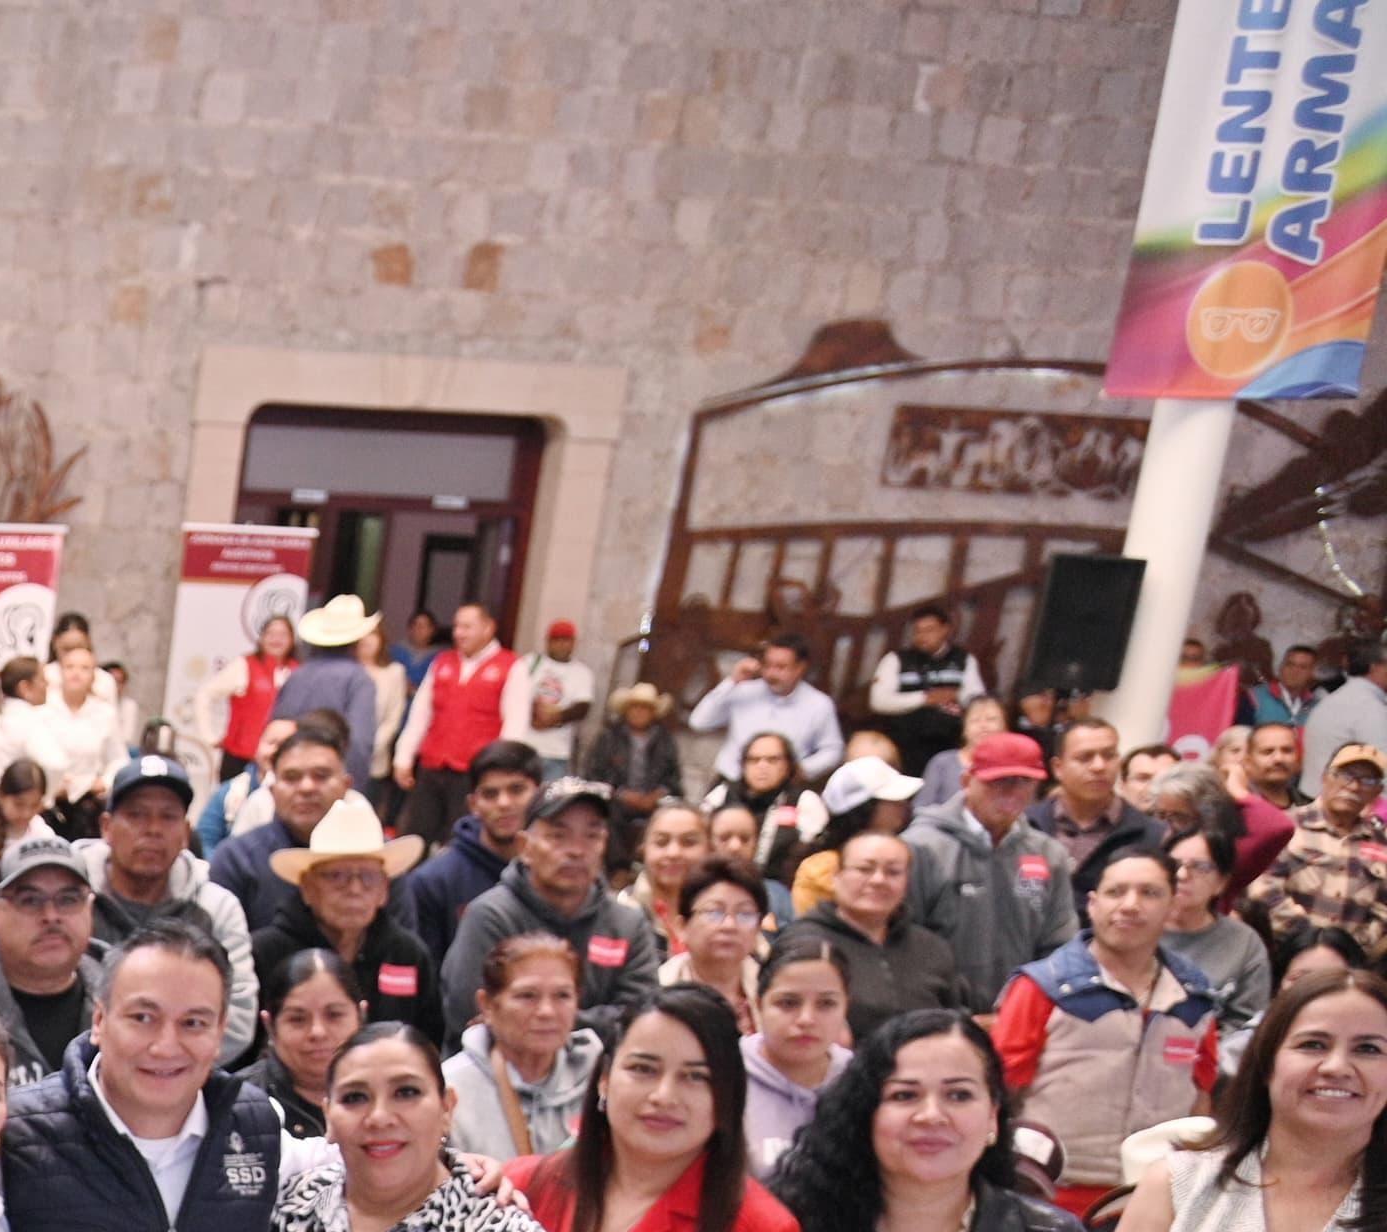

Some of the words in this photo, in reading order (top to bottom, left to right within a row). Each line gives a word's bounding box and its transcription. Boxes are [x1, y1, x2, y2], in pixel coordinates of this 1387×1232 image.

[1197, 0, 1292, 241] LENTE
[1269, 0, 1369, 261] ARMA
[225, 1166, 267, 1185] SSD
